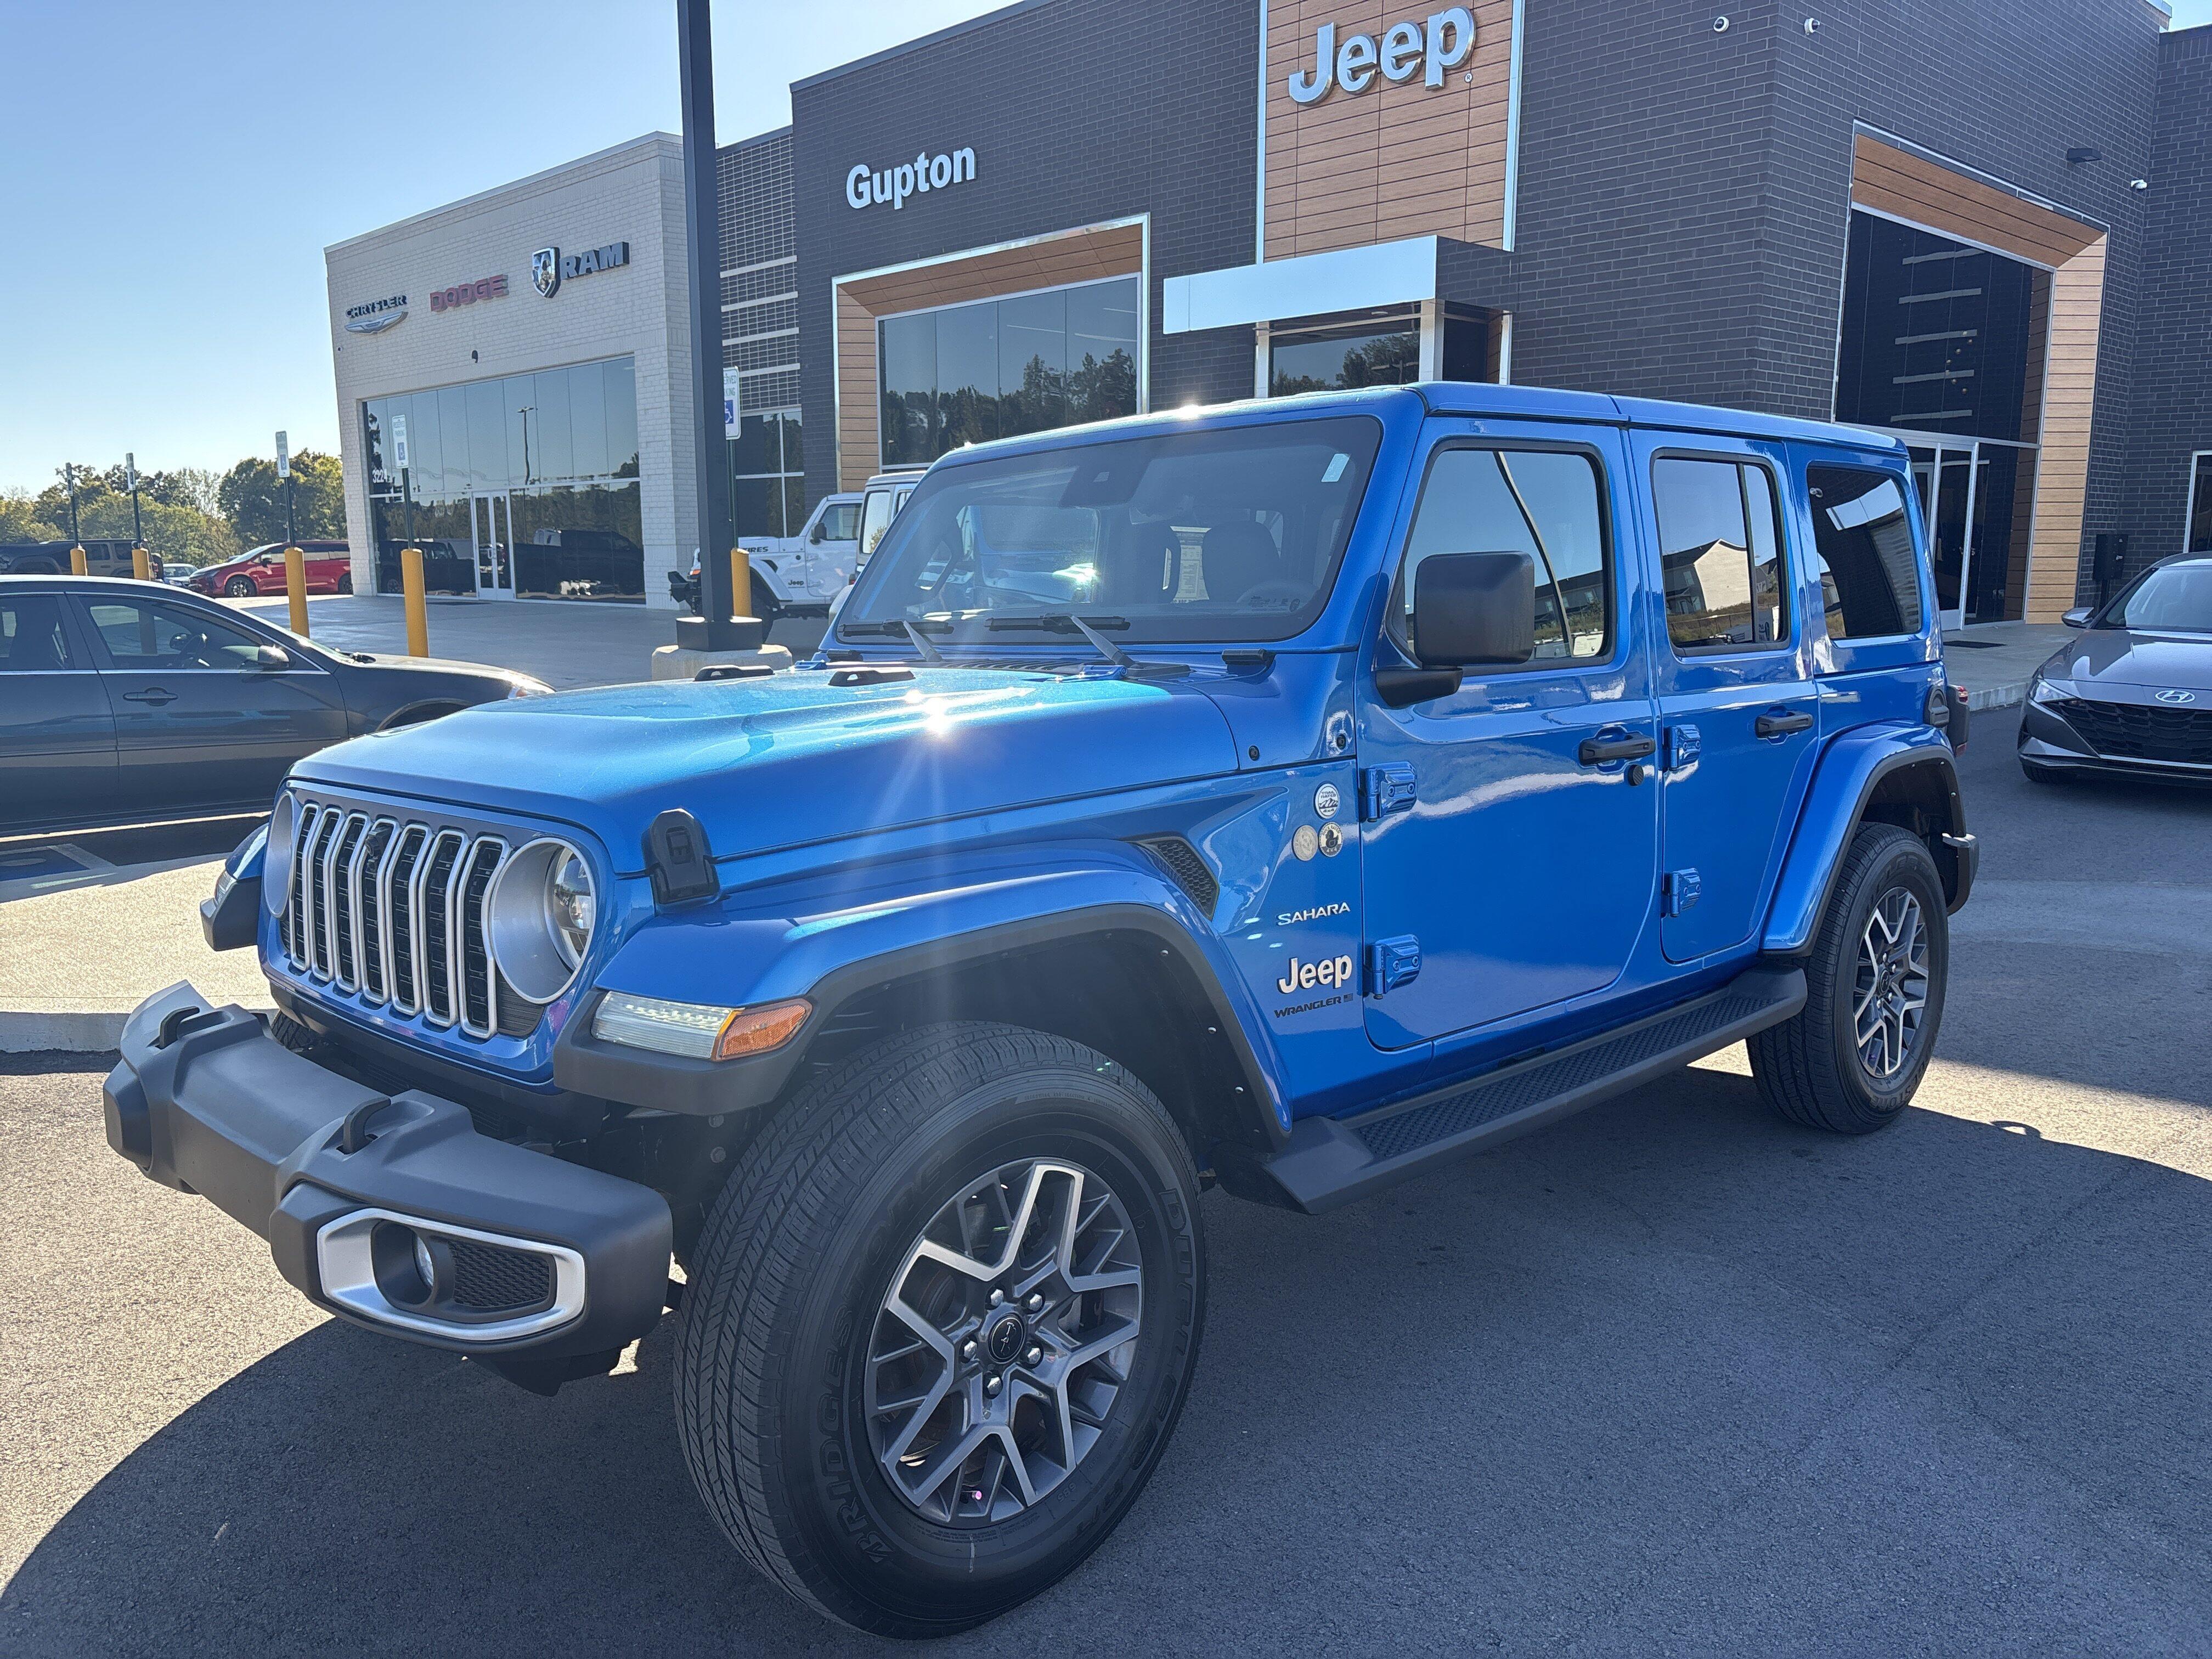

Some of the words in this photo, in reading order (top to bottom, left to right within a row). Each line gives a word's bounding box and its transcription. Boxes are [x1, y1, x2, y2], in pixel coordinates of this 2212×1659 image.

[1288, 6, 1476, 105] Jeep
[846, 147, 975, 210] Gupton
[560, 241, 627, 280] RAM
[346, 295, 408, 319] CHRYSLER
[430, 274, 509, 312] DODGE
[1278, 902, 1351, 926] SAHARA
[1278, 954, 1352, 994] Jeep
[1273, 996, 1342, 1019] WRANGLER
[818, 1150, 945, 1570] BRIDGESTONE
